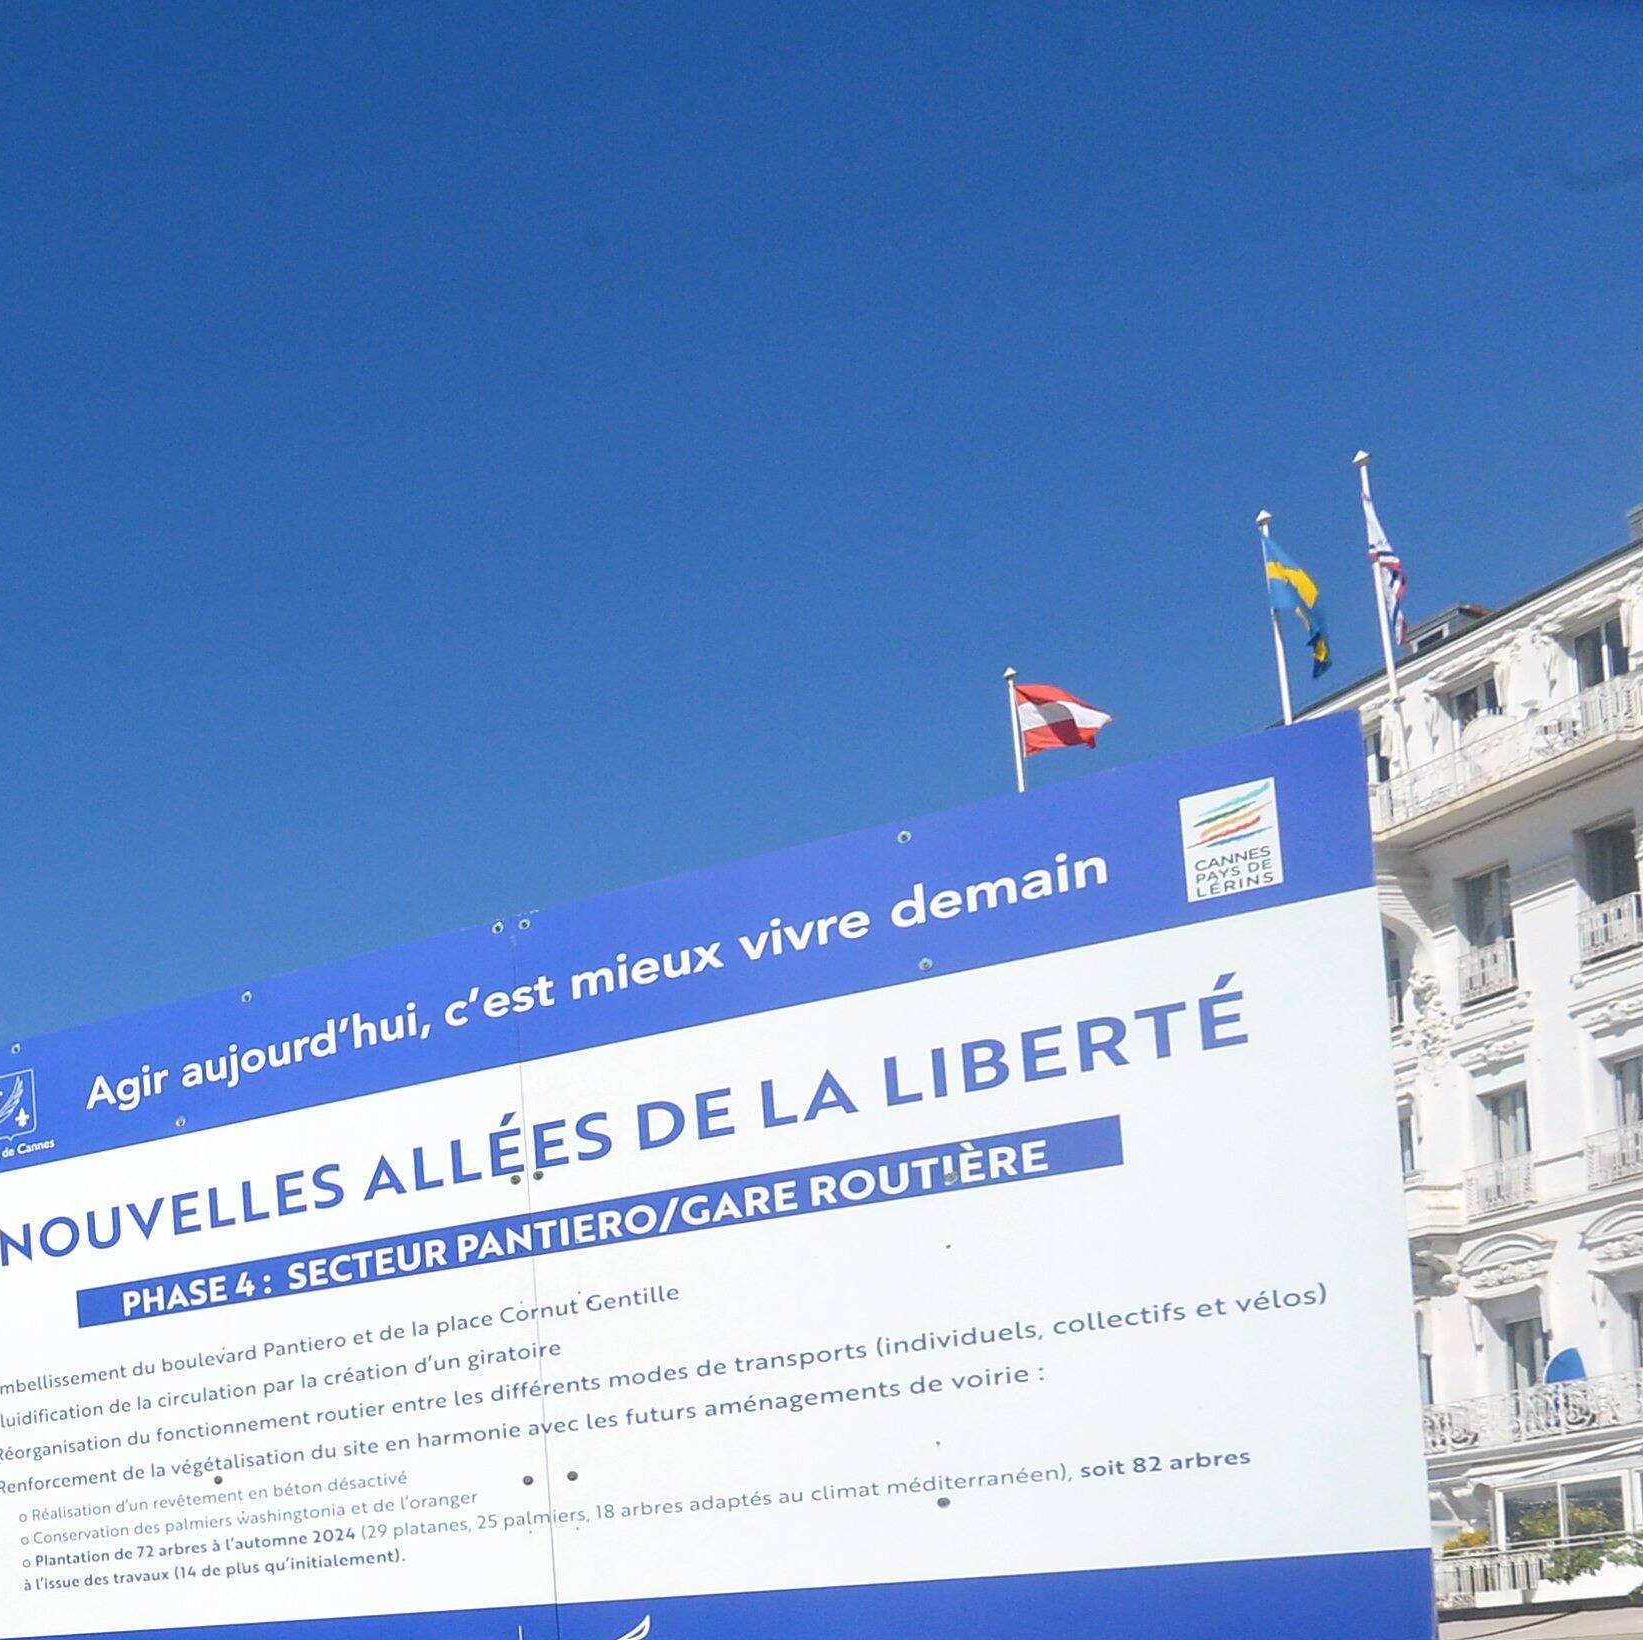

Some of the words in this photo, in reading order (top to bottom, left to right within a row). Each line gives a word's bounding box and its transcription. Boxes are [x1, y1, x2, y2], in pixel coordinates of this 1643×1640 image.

[1194, 845, 1271, 871] CANNES
[1196, 866, 1240, 884] PAYS
[1248, 858, 1272, 873] DE
[1196, 872, 1274, 898] LÉRINS
[86, 1064, 169, 1111] Agir
[181, 1002, 431, 1088] aujourd'hui,
[444, 975, 555, 1027] c'est
[571, 942, 724, 1000] mieux
[738, 910, 871, 961] vivre
[891, 852, 1108, 928] demain
[0, 1163, 345, 1267] NOUVELLES
[363, 1111, 613, 1201] ALLÉES
[636, 1087, 735, 1151] DE
[760, 1069, 859, 1129] LA
[883, 972, 1249, 1107] LIBERTÉ
[1, 1147, 15, 1158] de
[17, 1139, 55, 1155] Cannes
[122, 1275, 228, 1317] PHASE
[235, 1271, 256, 1297] 4
[287, 1239, 448, 1290] SECTEUR
[457, 1180, 798, 1263] PANTIERO/GARE
[810, 1139, 1049, 1207] ROUTIÈRE
[127, 1430, 151, 1446] du
[156, 1411, 311, 1442] fonctionnement
[316, 1402, 385, 1423] routier
[392, 1396, 447, 1414] entre
[454, 1390, 484, 1407] les
[490, 1376, 601, 1402] différents
[609, 1365, 689, 1388] modes
[696, 1359, 727, 1378] de
[734, 1344, 867, 1373] transports
[876, 1321, 1043, 1358] (individuels,
[1052, 1302, 1187, 1335] collectifs
[1195, 1298, 1227, 1318] et
[1235, 1282, 1327, 1313] vélos)
[132, 1361, 156, 1377] du
[161, 1344, 257, 1373] boulevard
[263, 1336, 347, 1358] Pantiero
[352, 1329, 374, 1345] et
[379, 1324, 405, 1342] de
[412, 1321, 429, 1337] la
[436, 1314, 493, 1338] place
[499, 1299, 579, 1324] Cornut
[585, 1285, 679, 1312] Gentille
[109, 1398, 132, 1414] de
[137, 1395, 152, 1411] la
[157, 1383, 257, 1408] circulation
[263, 1379, 295, 1399] par
[301, 1374, 317, 1389] la
[323, 1363, 408, 1386] création
[414, 1354, 461, 1374] d'un
[467, 1342, 561, 1372] giratoire
[122, 1465, 145, 1481] de
[151, 1463, 166, 1478] la
[170, 1449, 305, 1478] végétalisation
[310, 1444, 336, 1460] du
[343, 1440, 379, 1457] site
[385, 1438, 410, 1452] en
[417, 1422, 521, 1448] harmonie
[528, 1419, 579, 1436] avec
[586, 1413, 618, 1430] les
[625, 1406, 697, 1426] futurs
[704, 1382, 901, 1417] aménagements
[909, 1375, 943, 1395] de
[951, 1366, 1029, 1390] voirie
[31, 1503, 111, 1521] Réalisation
[115, 1498, 149, 1513] d'un
[153, 1489, 244, 1510] revêtement
[248, 1488, 268, 1500] en
[273, 1482, 323, 1498] béton
[327, 1470, 408, 1492] désactivé
[33, 1526, 129, 1545] Conservation
[133, 1522, 161, 1535] des
[165, 1516, 233, 1536] palmiers
[236, 1503, 346, 1525] washingtonia
[351, 1502, 369, 1515] et
[373, 1499, 395, 1513] de
[400, 1493, 478, 1511] l'oranger
[35, 1550, 110, 1567] Plantation
[114, 1547, 133, 1561] de
[136, 1544, 155, 1558] 72
[158, 1542, 208, 1557] arbres
[212, 1539, 221, 1553] à
[225, 1534, 308, 1551] l'automne
[312, 1527, 356, 1544] 2024
[361, 1524, 388, 1540] (29
[393, 1520, 472, 1540] platanes,
[477, 1513, 498, 1530] 25
[503, 1504, 590, 1531] palmiers,
[596, 1503, 615, 1519] 18
[621, 1501, 683, 1518] arbres
[690, 1490, 772, 1513] adaptés
[778, 1491, 803, 1504] au
[810, 1482, 880, 1501] climat
[887, 1462, 1072, 1495] méditerranéen),
[1080, 1459, 1126, 1479] soit
[1132, 1455, 1163, 1474] 82
[1169, 1451, 1252, 1470] arbres
[24, 1578, 32, 1592] à
[35, 1576, 80, 1590] l'issue
[83, 1573, 109, 1587] des
[113, 1571, 170, 1584] travaux
[174, 1565, 197, 1580] (14
[201, 1564, 221, 1577] de
[226, 1562, 260, 1579] plus
[264, 1547, 406, 1576] qu'initialement).
